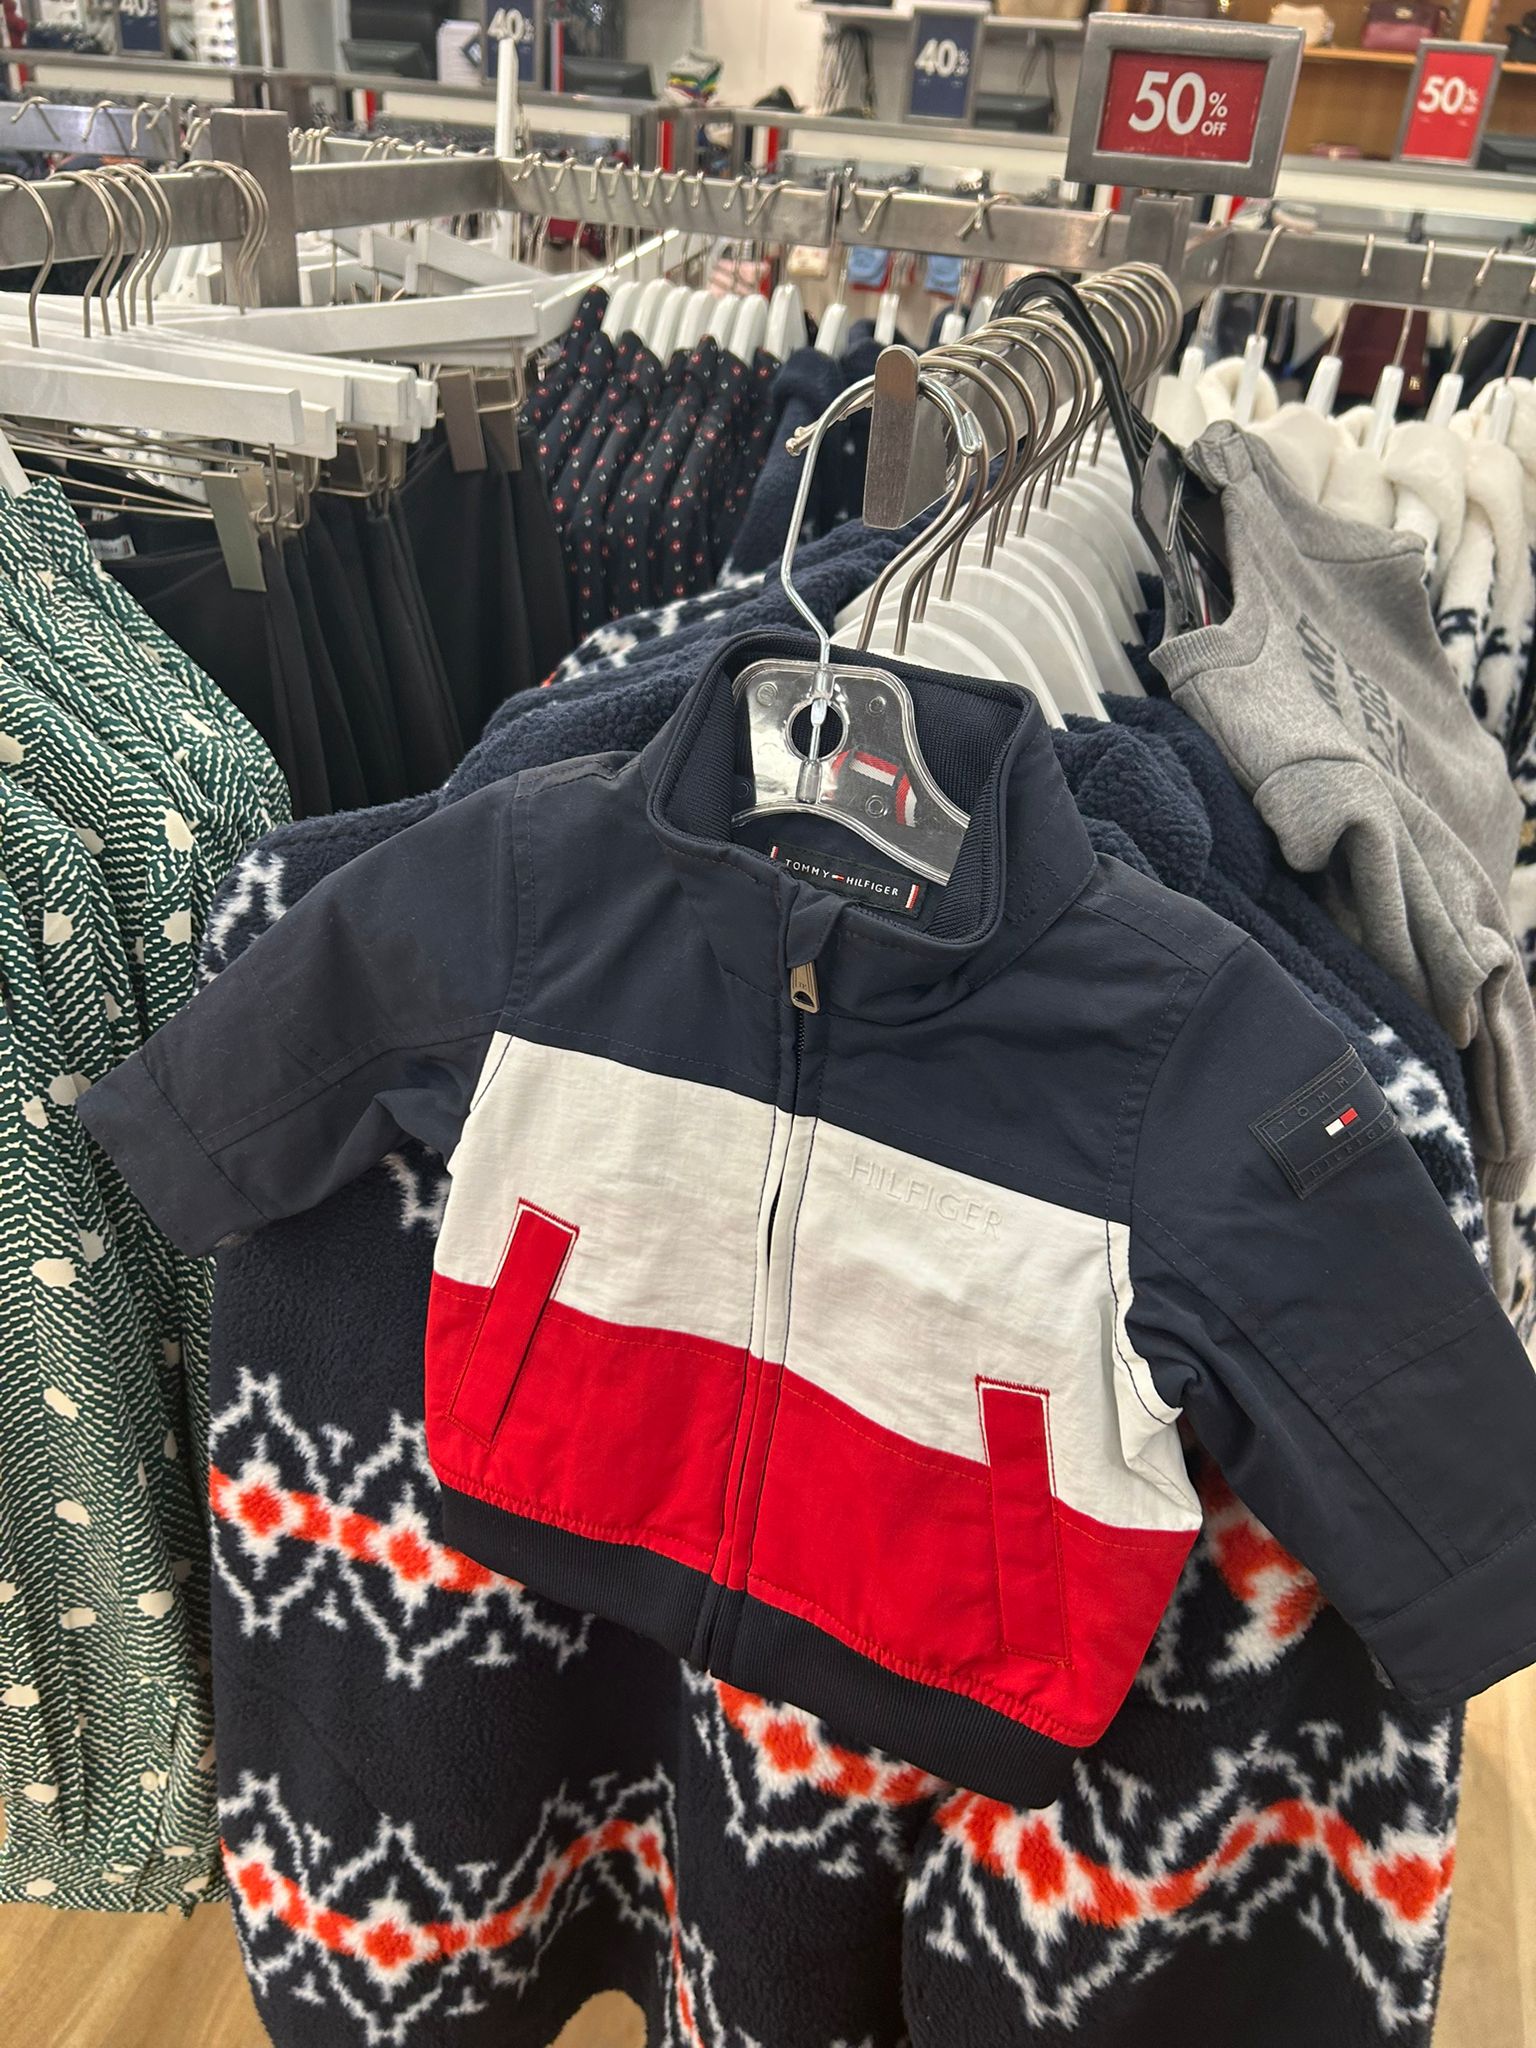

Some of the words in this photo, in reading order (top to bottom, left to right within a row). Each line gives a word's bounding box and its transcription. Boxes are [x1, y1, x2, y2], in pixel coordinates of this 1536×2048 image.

[1201, 121, 1228, 136] OFF
[784, 858, 829, 879] TOMMY
[845, 876, 899, 897] HILFIGER
[1279, 1063, 1364, 1131] TOMMY
[1310, 1109, 1397, 1178] HILFIGER
[849, 1154, 1003, 1241] HILFIGER
